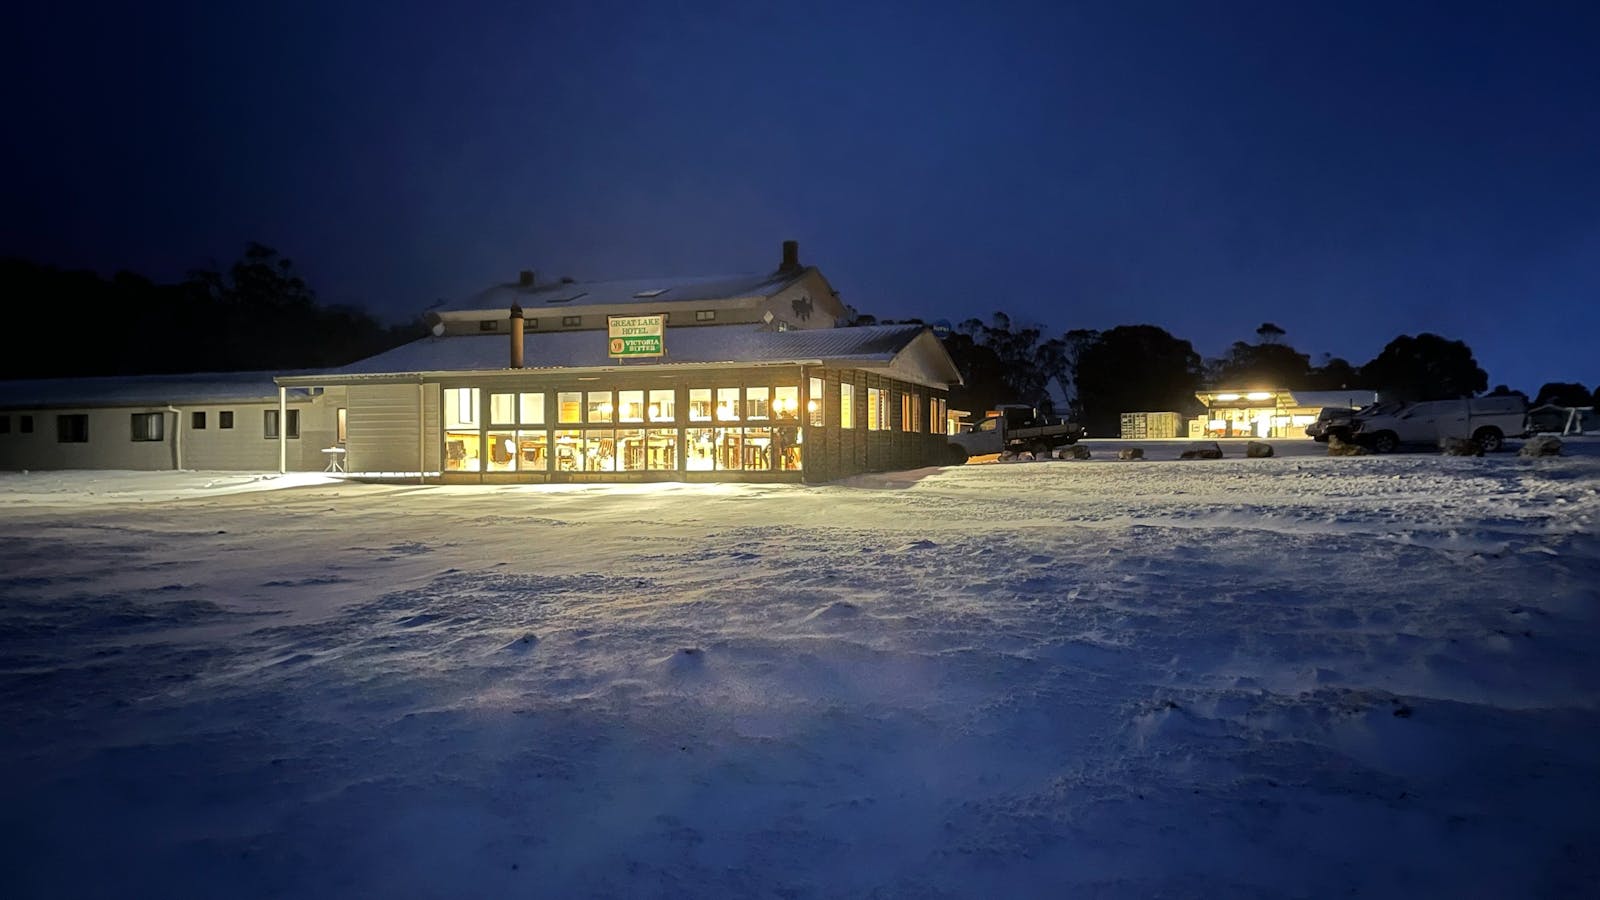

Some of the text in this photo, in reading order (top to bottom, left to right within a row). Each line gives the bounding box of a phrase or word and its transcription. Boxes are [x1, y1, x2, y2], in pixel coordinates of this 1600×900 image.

[610, 318, 660, 327] GREAT LAKE
[622, 327, 648, 335] HOTEL
